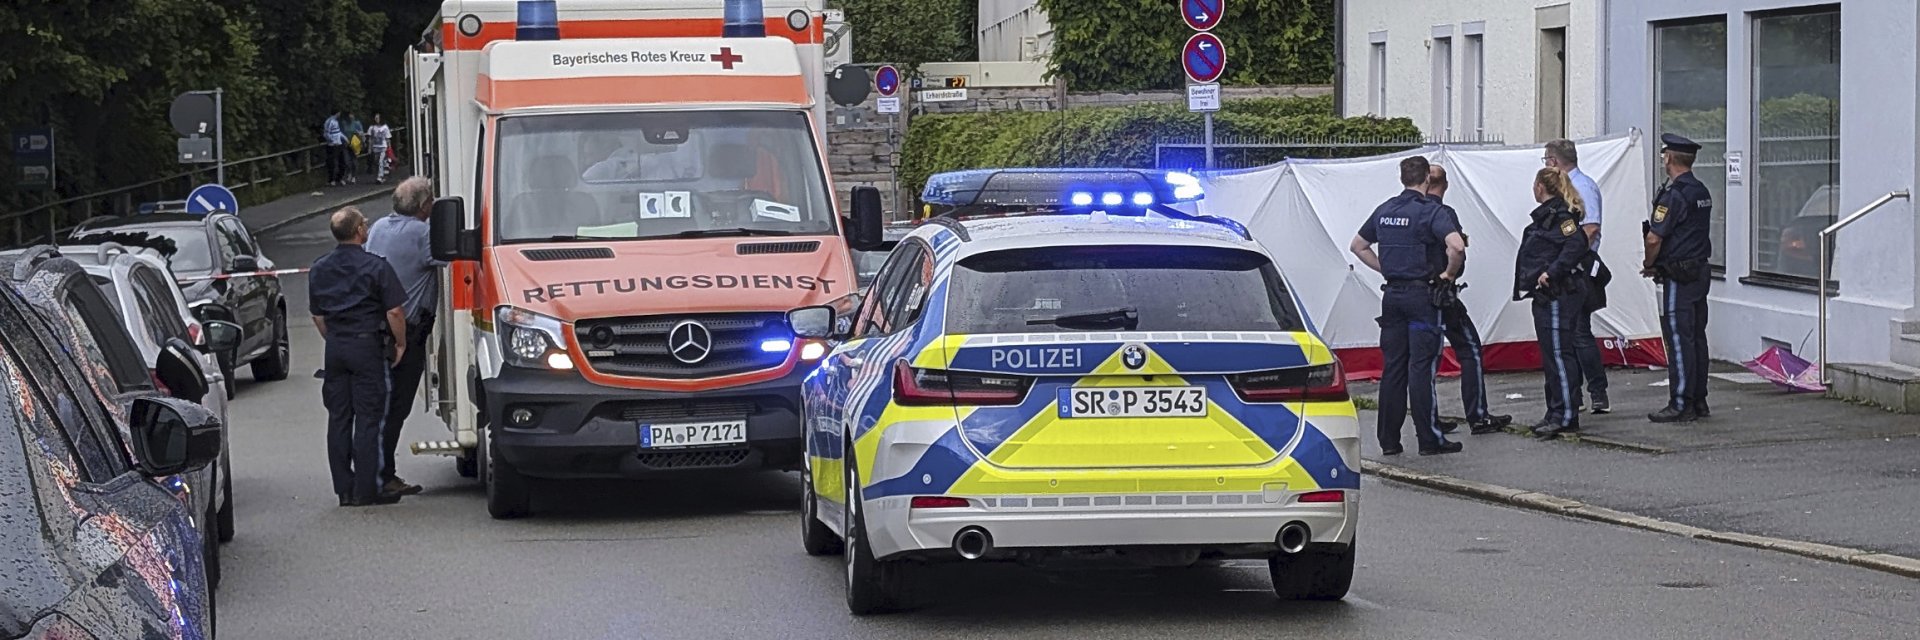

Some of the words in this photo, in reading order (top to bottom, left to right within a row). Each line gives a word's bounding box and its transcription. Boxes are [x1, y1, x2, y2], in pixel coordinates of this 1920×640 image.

[553, 53, 628, 67] Bayerisches
[631, 51, 667, 63] Rotes
[670, 50, 706, 62] Kreuz
[20, 137, 28, 149] P
[1380, 217, 1409, 226] POLIZEI
[523, 275, 836, 303] RETTUNGSDIENST
[991, 348, 1082, 369] POLIZEI
[1062, 405, 1069, 413] D
[1074, 391, 1105, 414] SR
[1124, 391, 1138, 413] P
[1143, 390, 1204, 414] 3543
[651, 427, 674, 444] PA
[685, 425, 697, 442] P
[700, 423, 743, 442] 7171
